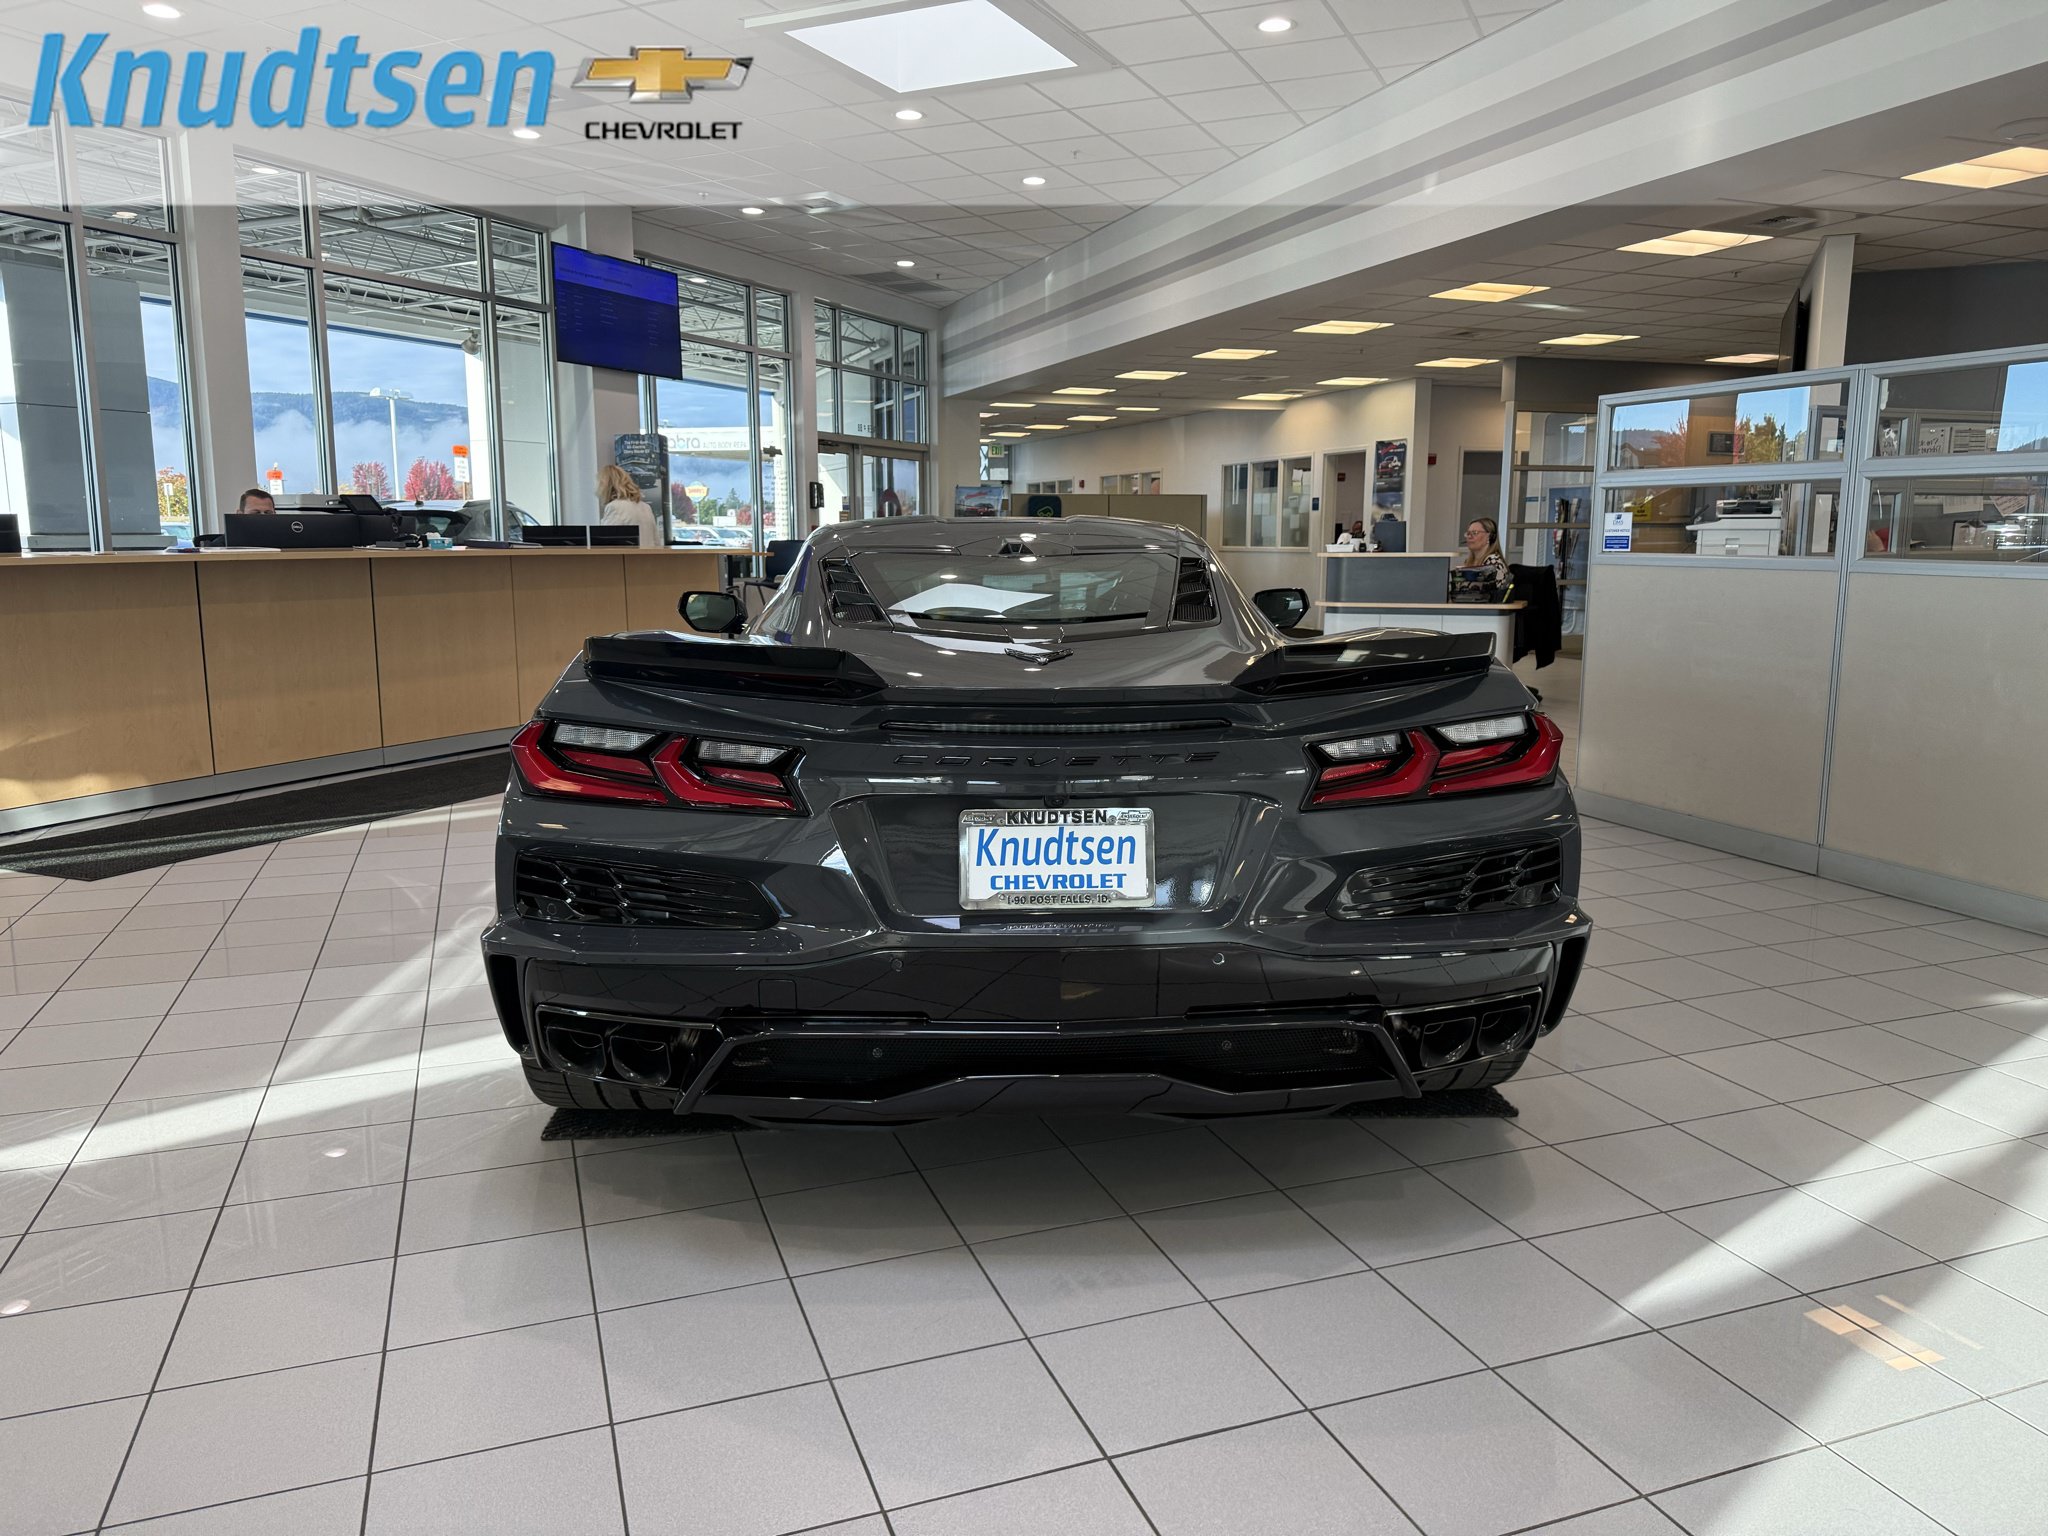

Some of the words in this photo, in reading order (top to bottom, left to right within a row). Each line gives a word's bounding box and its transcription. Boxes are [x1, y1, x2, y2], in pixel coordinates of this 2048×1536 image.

[893, 751, 1221, 768] CORVETTE
[1006, 810, 1108, 825] KNUDTSEN
[975, 826, 1137, 867] Knudtsen
[989, 873, 1127, 890] CHEVROLET
[1029, 895, 1057, 904] POST
